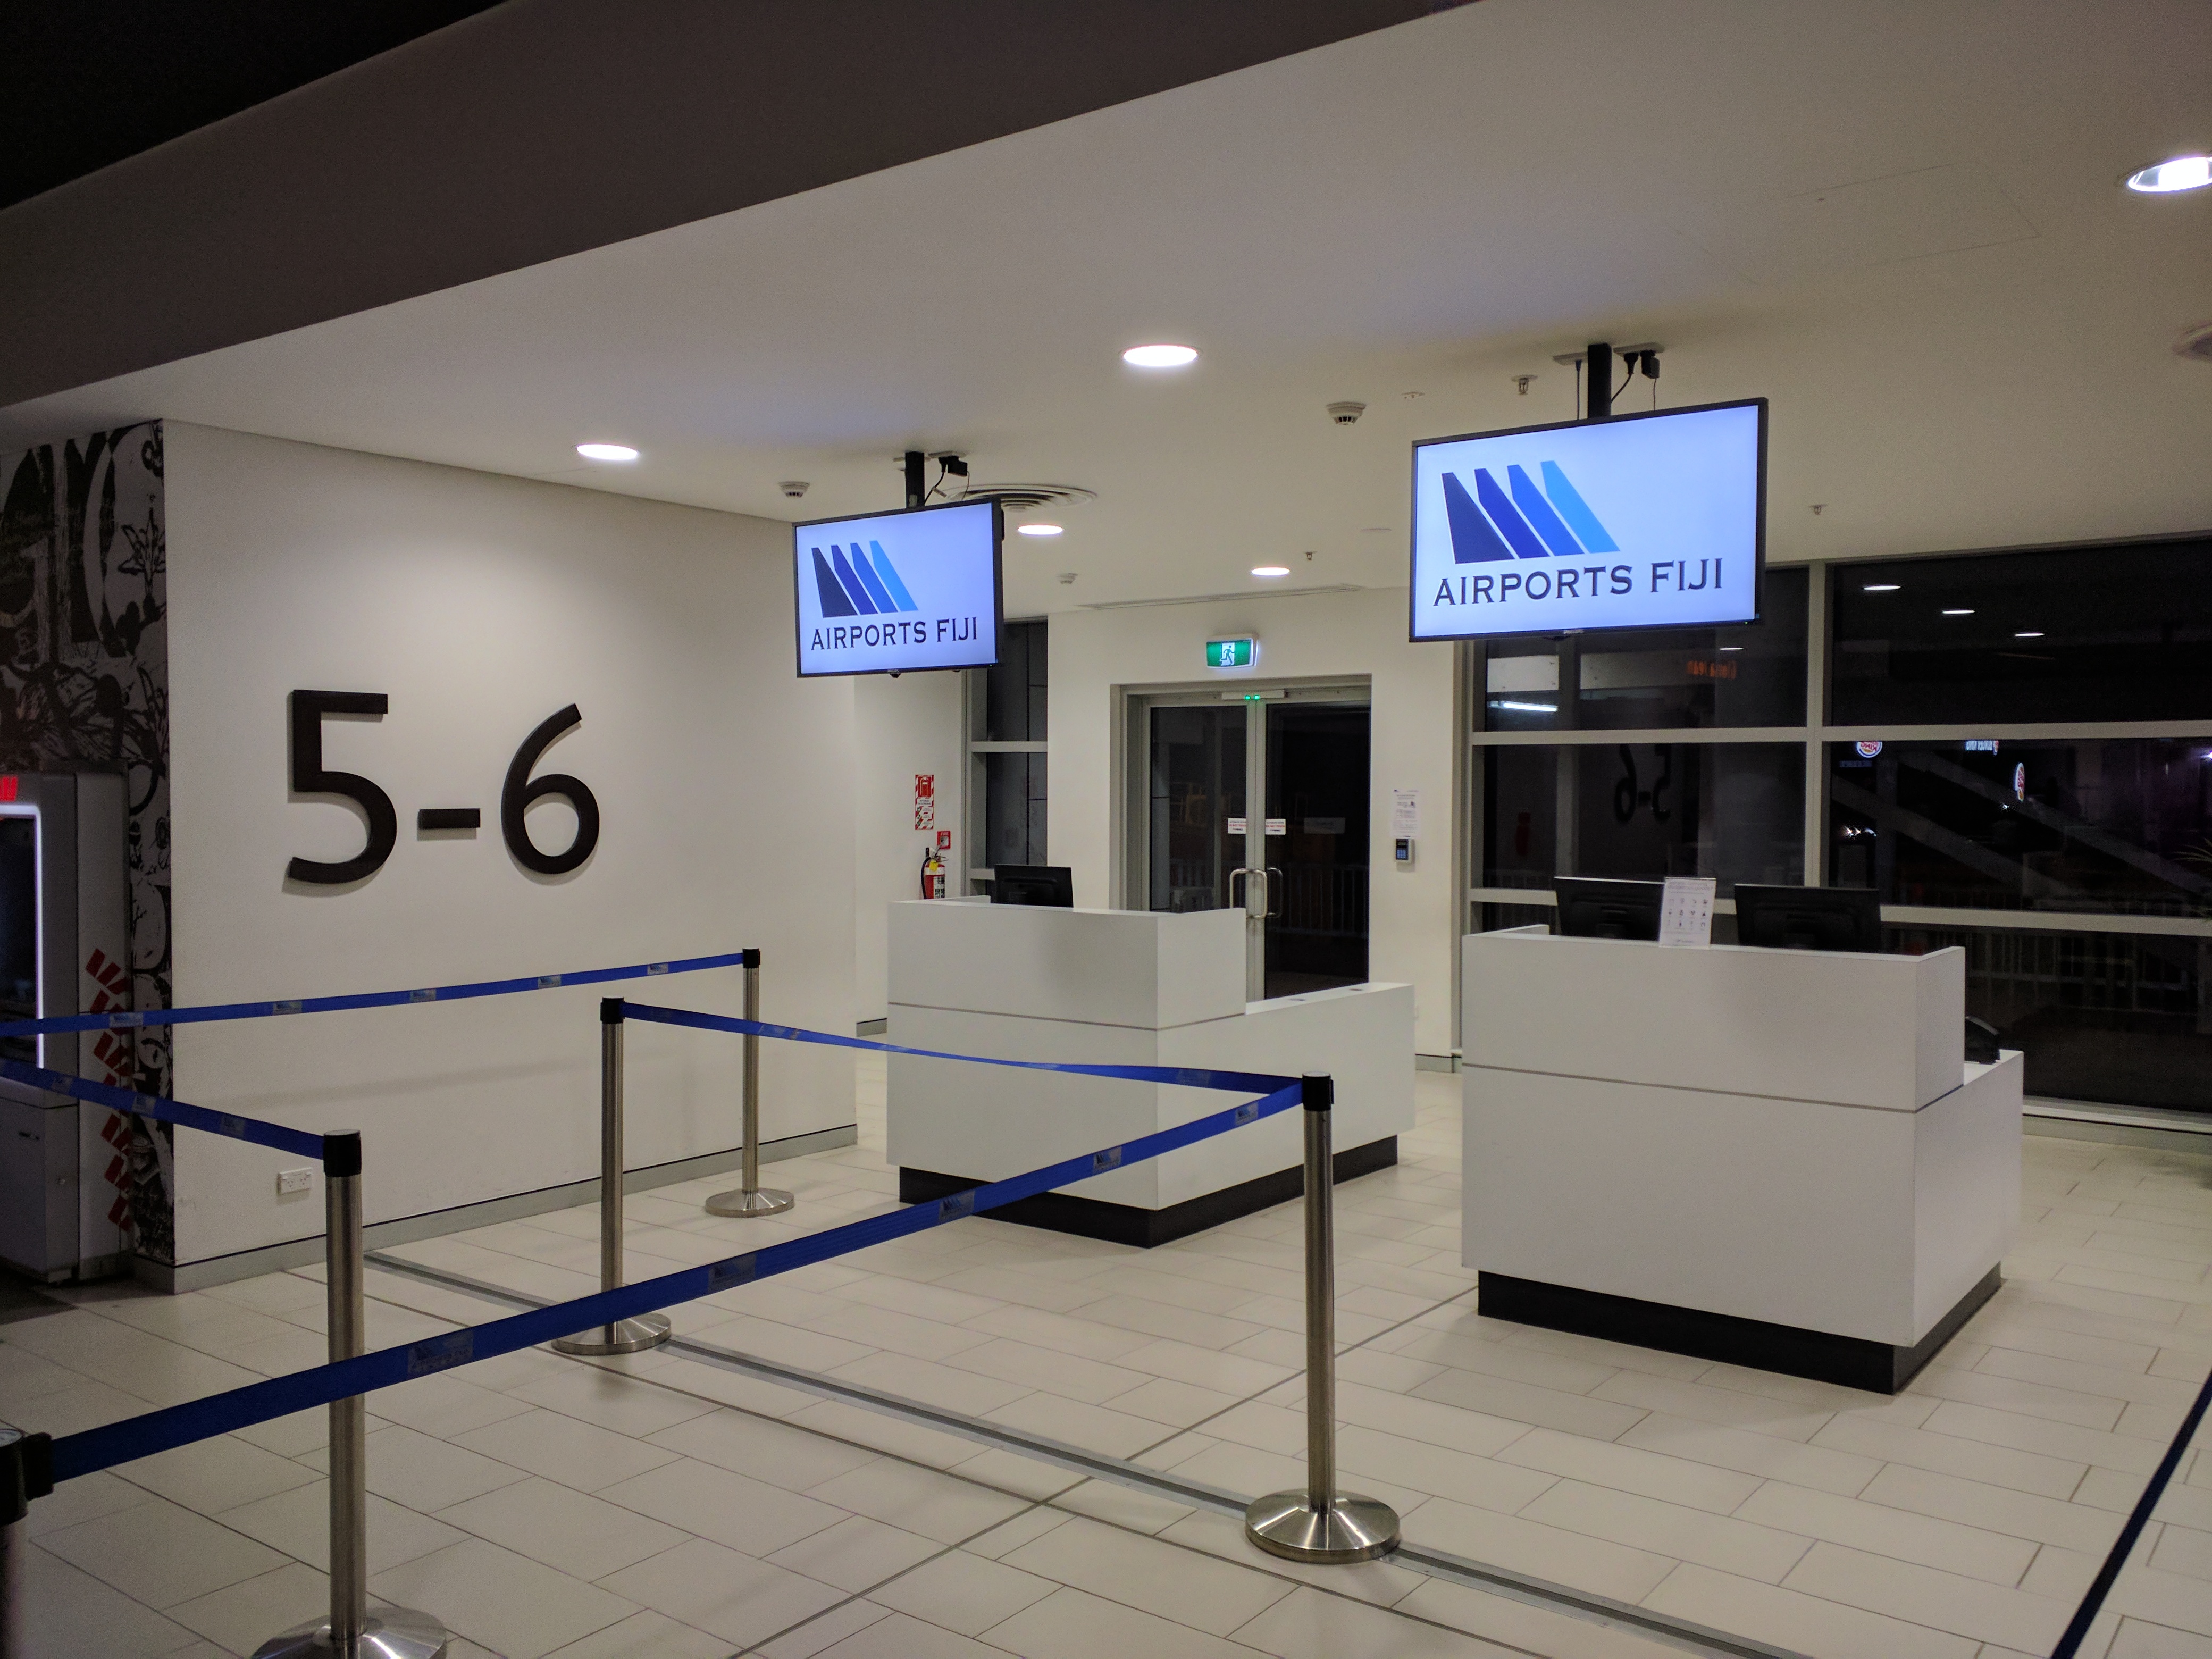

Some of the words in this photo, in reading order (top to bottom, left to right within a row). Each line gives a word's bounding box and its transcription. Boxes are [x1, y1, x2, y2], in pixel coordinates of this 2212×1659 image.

[1432, 565, 1633, 607] AIRPORTS
[1650, 558, 1723, 593] FIJI
[811, 621, 926, 650] AIRPORTS
[936, 617, 977, 642] FIJI
[288, 689, 600, 884] 5-6
